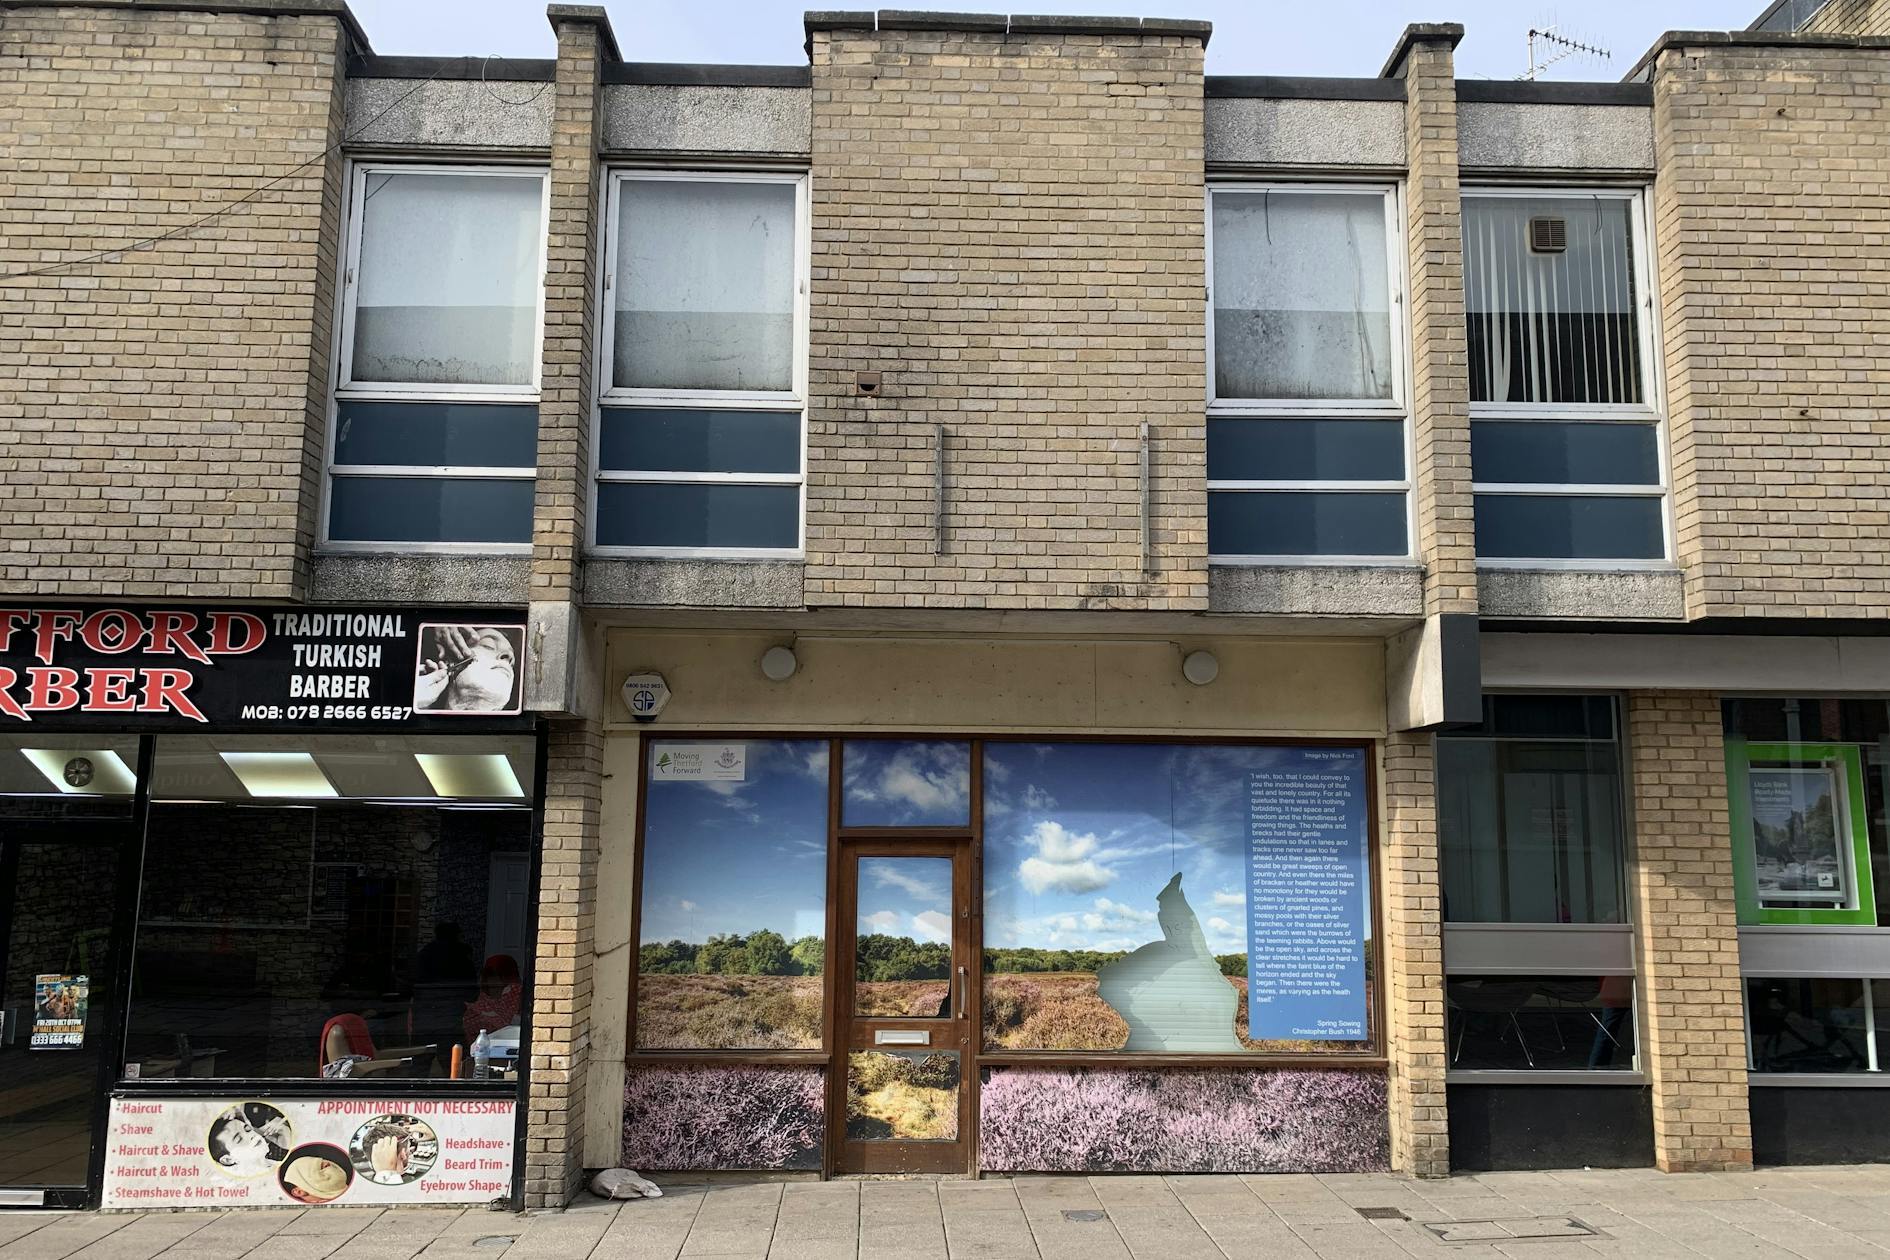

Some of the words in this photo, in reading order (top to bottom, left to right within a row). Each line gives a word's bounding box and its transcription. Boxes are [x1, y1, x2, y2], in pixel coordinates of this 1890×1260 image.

[273, 614, 406, 637] TRADITIONAL
[293, 644, 382, 668] TURKISH
[290, 674, 370, 698] BARBER
[241, 705, 283, 719] MOB:
[287, 705, 320, 719] 078
[324, 706, 366, 719] 2666
[370, 706, 412, 720] 6527
[31, 1036, 48, 1044] 0333
[122, 1103, 162, 1114] Haircut
[318, 1101, 411, 1114] APPOINTMENT
[414, 1101, 440, 1114] NOT
[443, 1101, 513, 1114] NECESSARY
[121, 1124, 153, 1134] Shave
[446, 1138, 504, 1149] Headshave
[119, 1145, 158, 1156] Haircut
[161, 1146, 169, 1155] &
[172, 1145, 204, 1155] Shave
[445, 1159, 476, 1170] Beard
[479, 1159, 502, 1170] Trim
[118, 1166, 157, 1177] Haircut
[160, 1167, 168, 1176] &
[172, 1166, 199, 1176] Wash
[420, 1180, 466, 1193] Eyebrow
[469, 1179, 501, 1193] Shape
[116, 1187, 182, 1198] Steamshave
[184, 1188, 192, 1197] &
[195, 1187, 214, 1197] Hot
[218, 1186, 249, 1197] Towel
